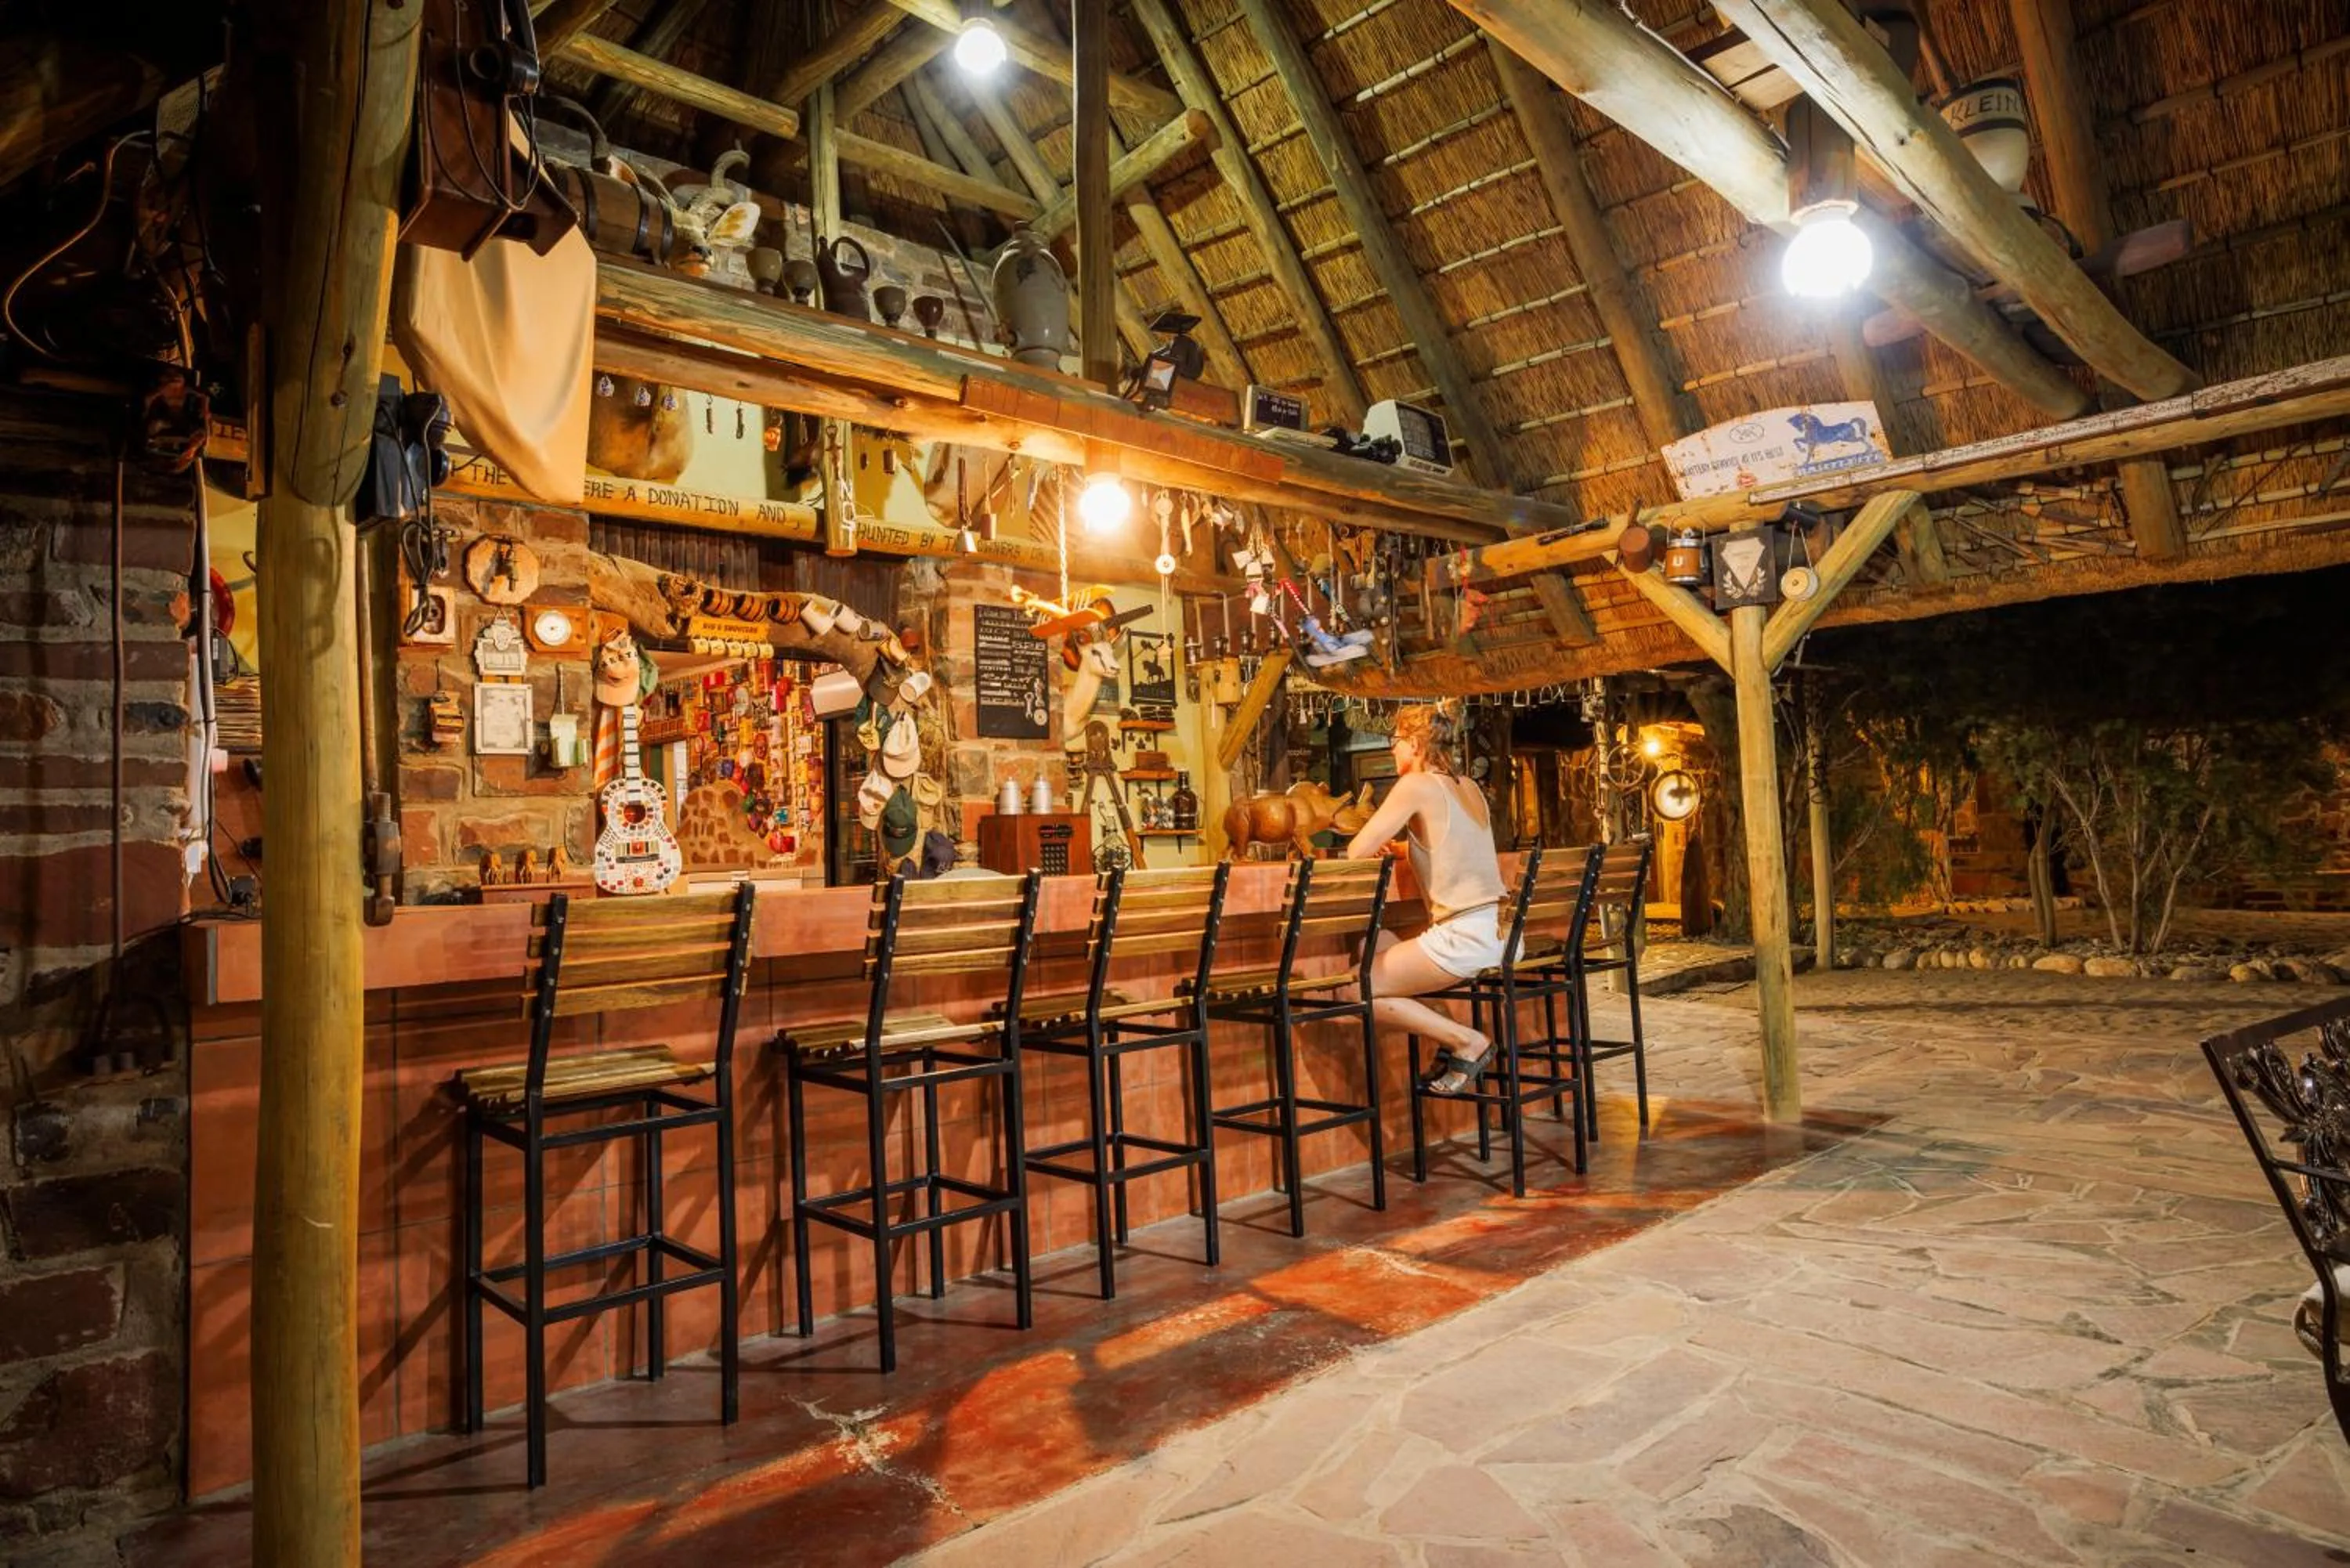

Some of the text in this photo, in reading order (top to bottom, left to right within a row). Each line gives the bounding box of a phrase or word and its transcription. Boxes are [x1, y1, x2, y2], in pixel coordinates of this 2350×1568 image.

[584, 480, 614, 499] ERE
[624, 486, 637, 501] A
[648, 487, 739, 516] DONATION
[856, 522, 909, 546] HUNTED
[919, 532, 935, 548] BY
